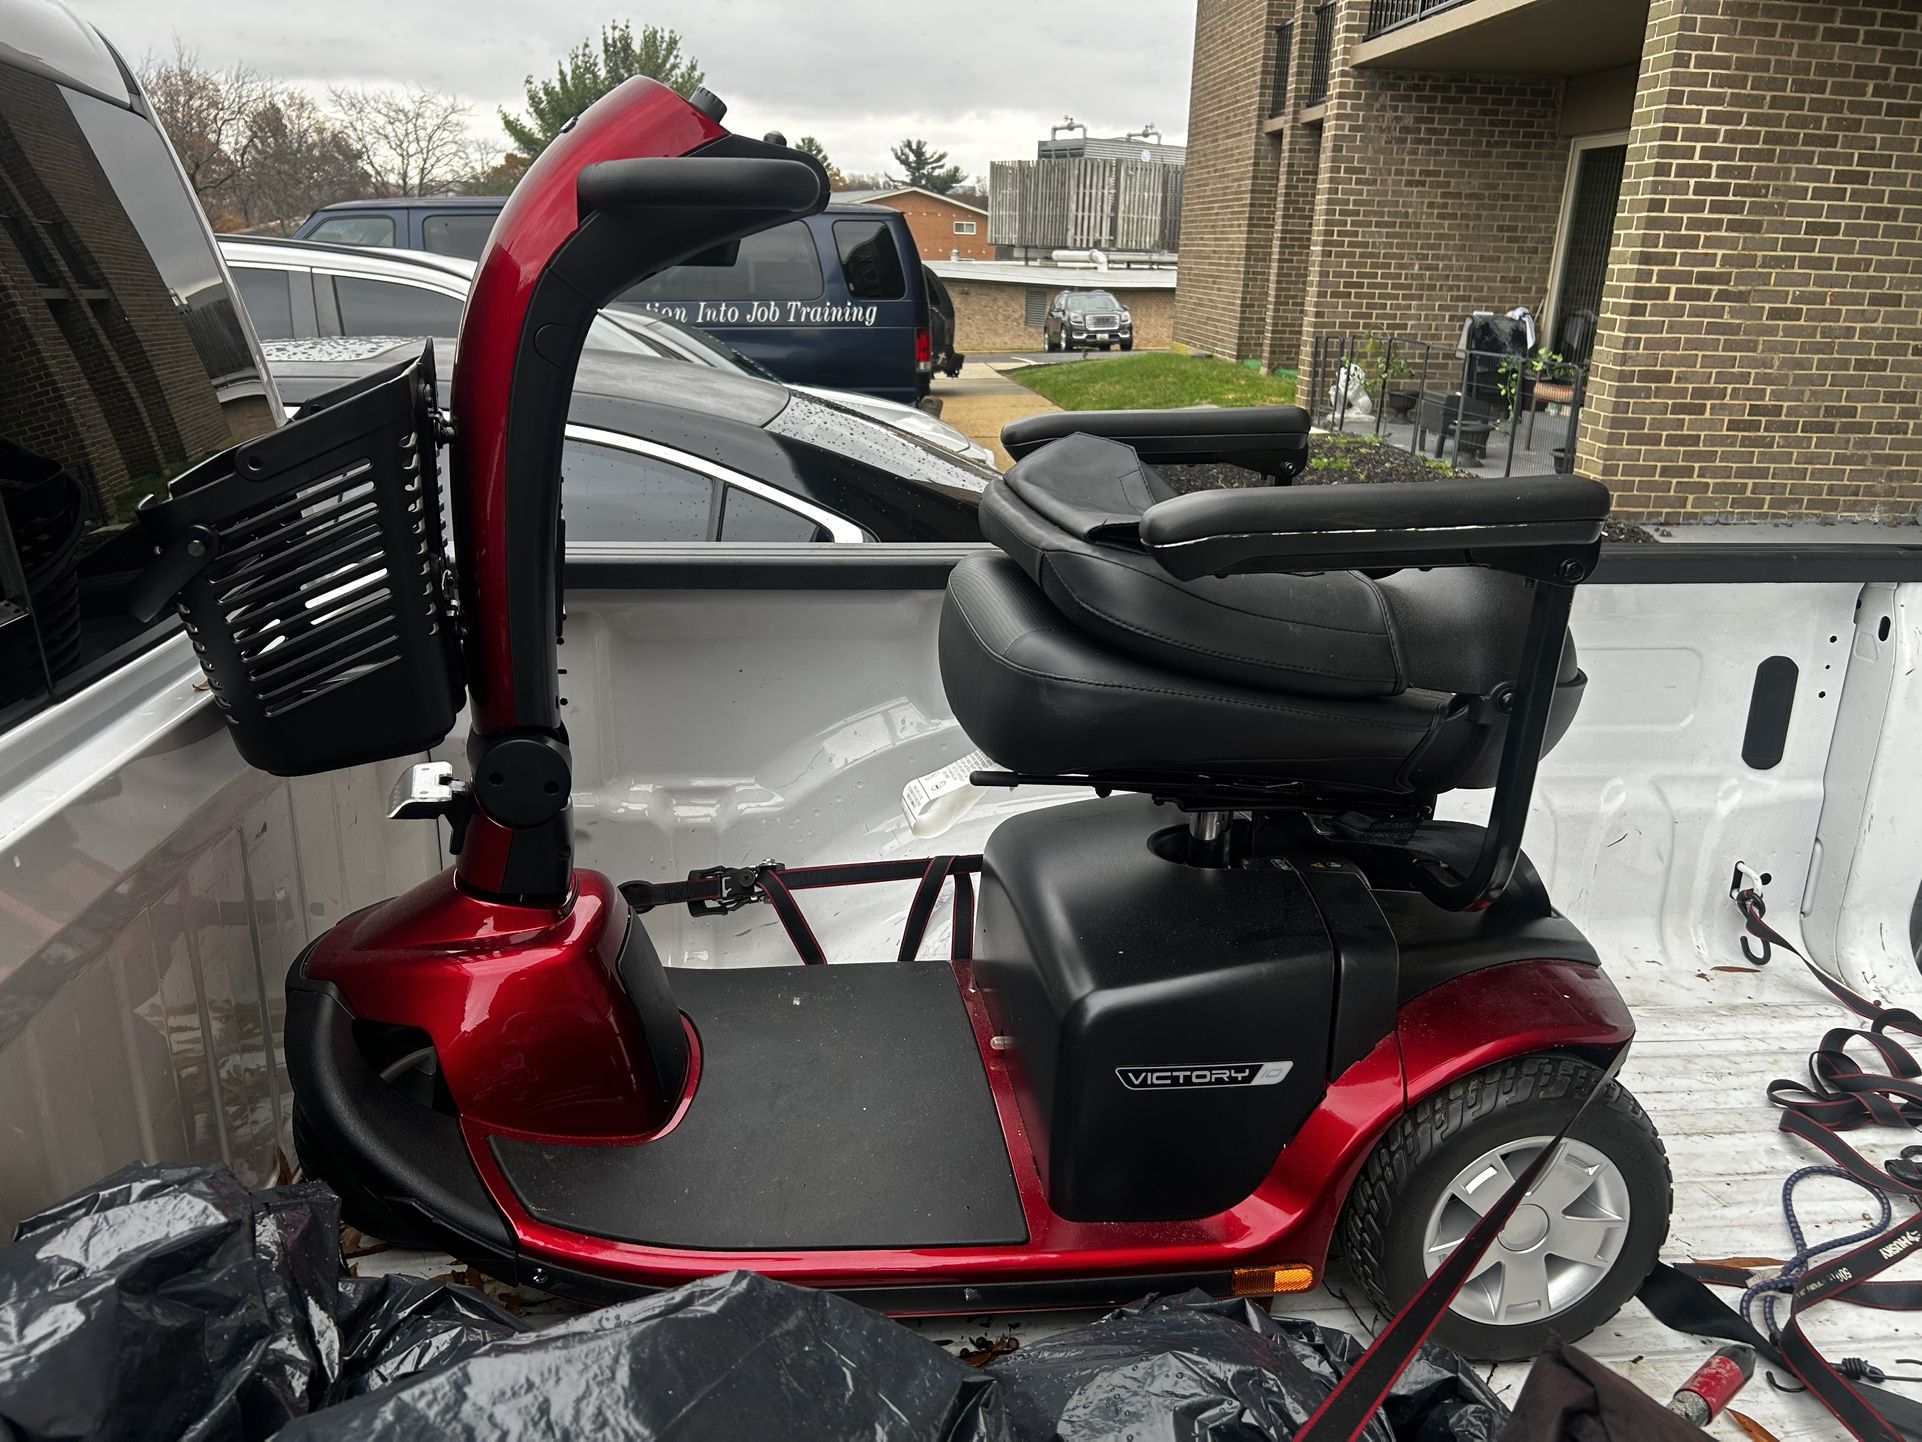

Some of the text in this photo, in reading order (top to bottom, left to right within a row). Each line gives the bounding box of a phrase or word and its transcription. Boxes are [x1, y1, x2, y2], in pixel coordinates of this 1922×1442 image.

[696, 302, 739, 323] Into
[746, 301, 780, 323] Job
[787, 301, 877, 326] Training
[1128, 1068, 1249, 1085] VICTORY
[1879, 1235, 1913, 1259] HUSKY
